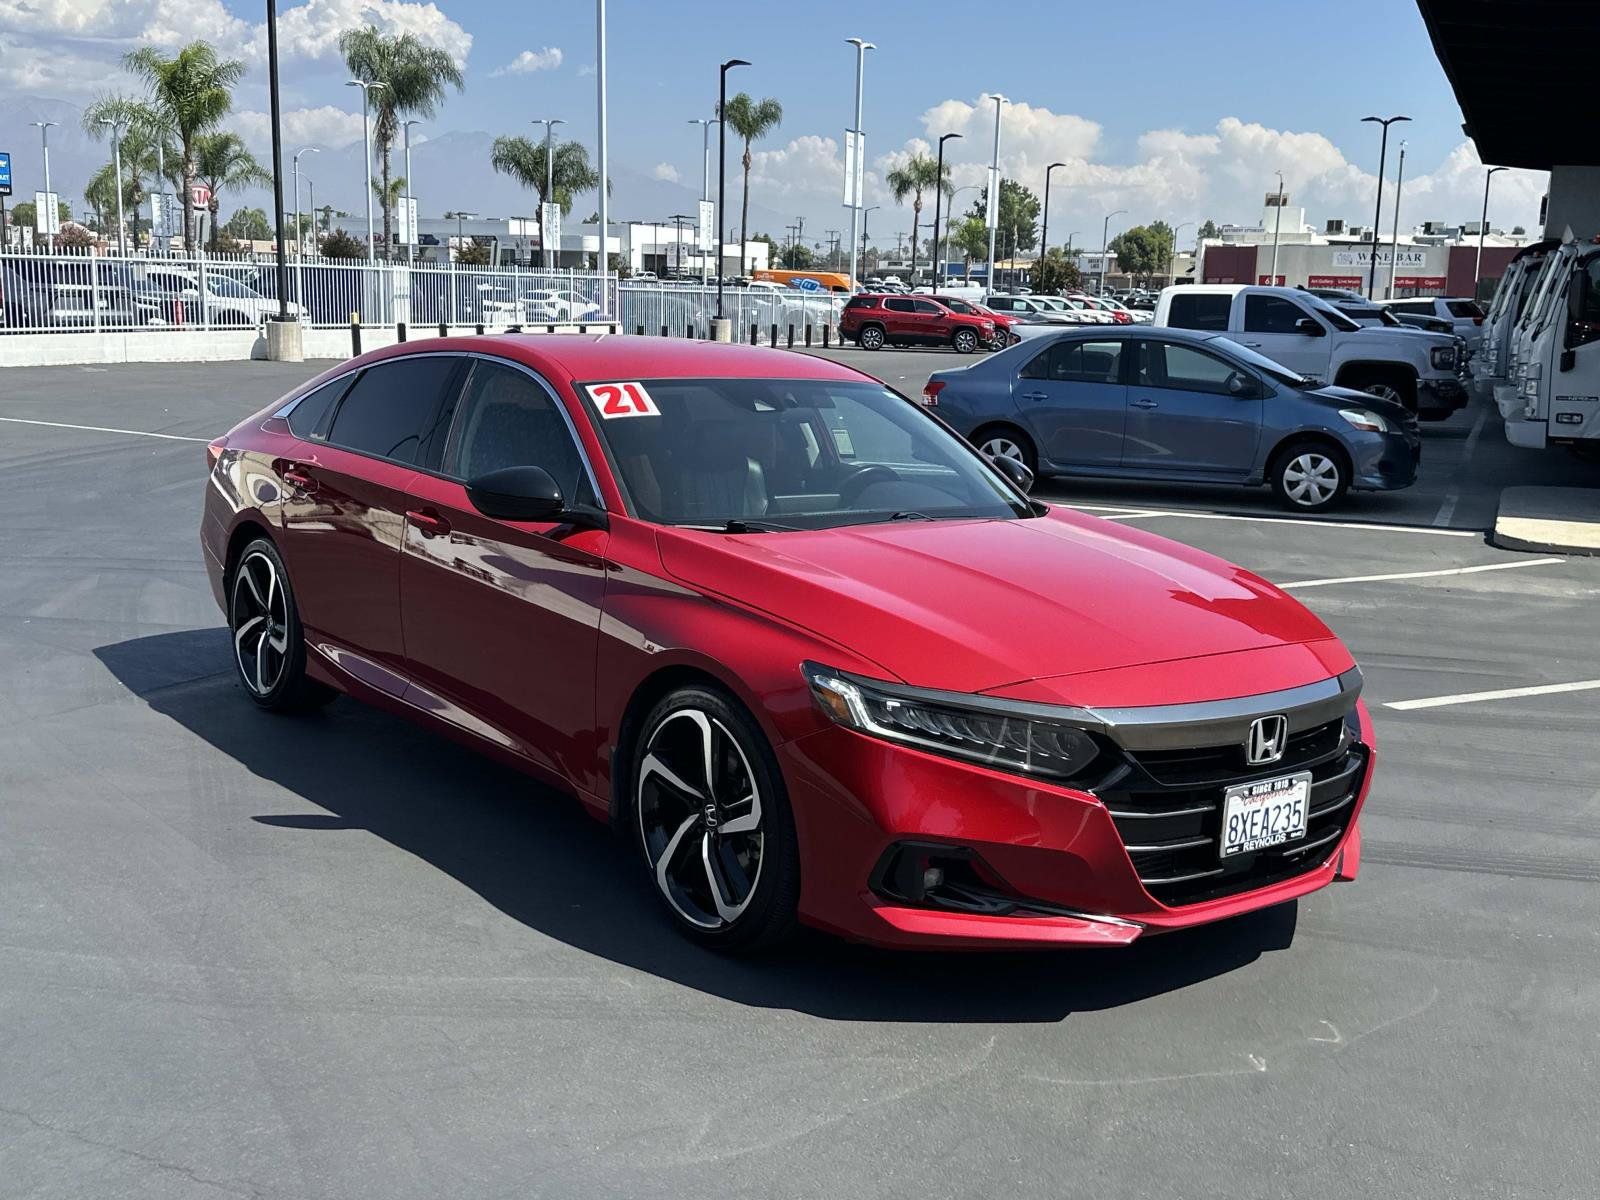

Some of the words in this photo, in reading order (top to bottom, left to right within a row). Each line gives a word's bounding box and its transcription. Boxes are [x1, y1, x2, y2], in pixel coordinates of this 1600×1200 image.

[1396, 253, 1422, 262] BAR
[592, 384, 649, 415] 21
[1252, 782, 1272, 794] SINCE
[1228, 799, 1302, 844] 8XEA235
[1243, 832, 1287, 852] REYNOLDS
